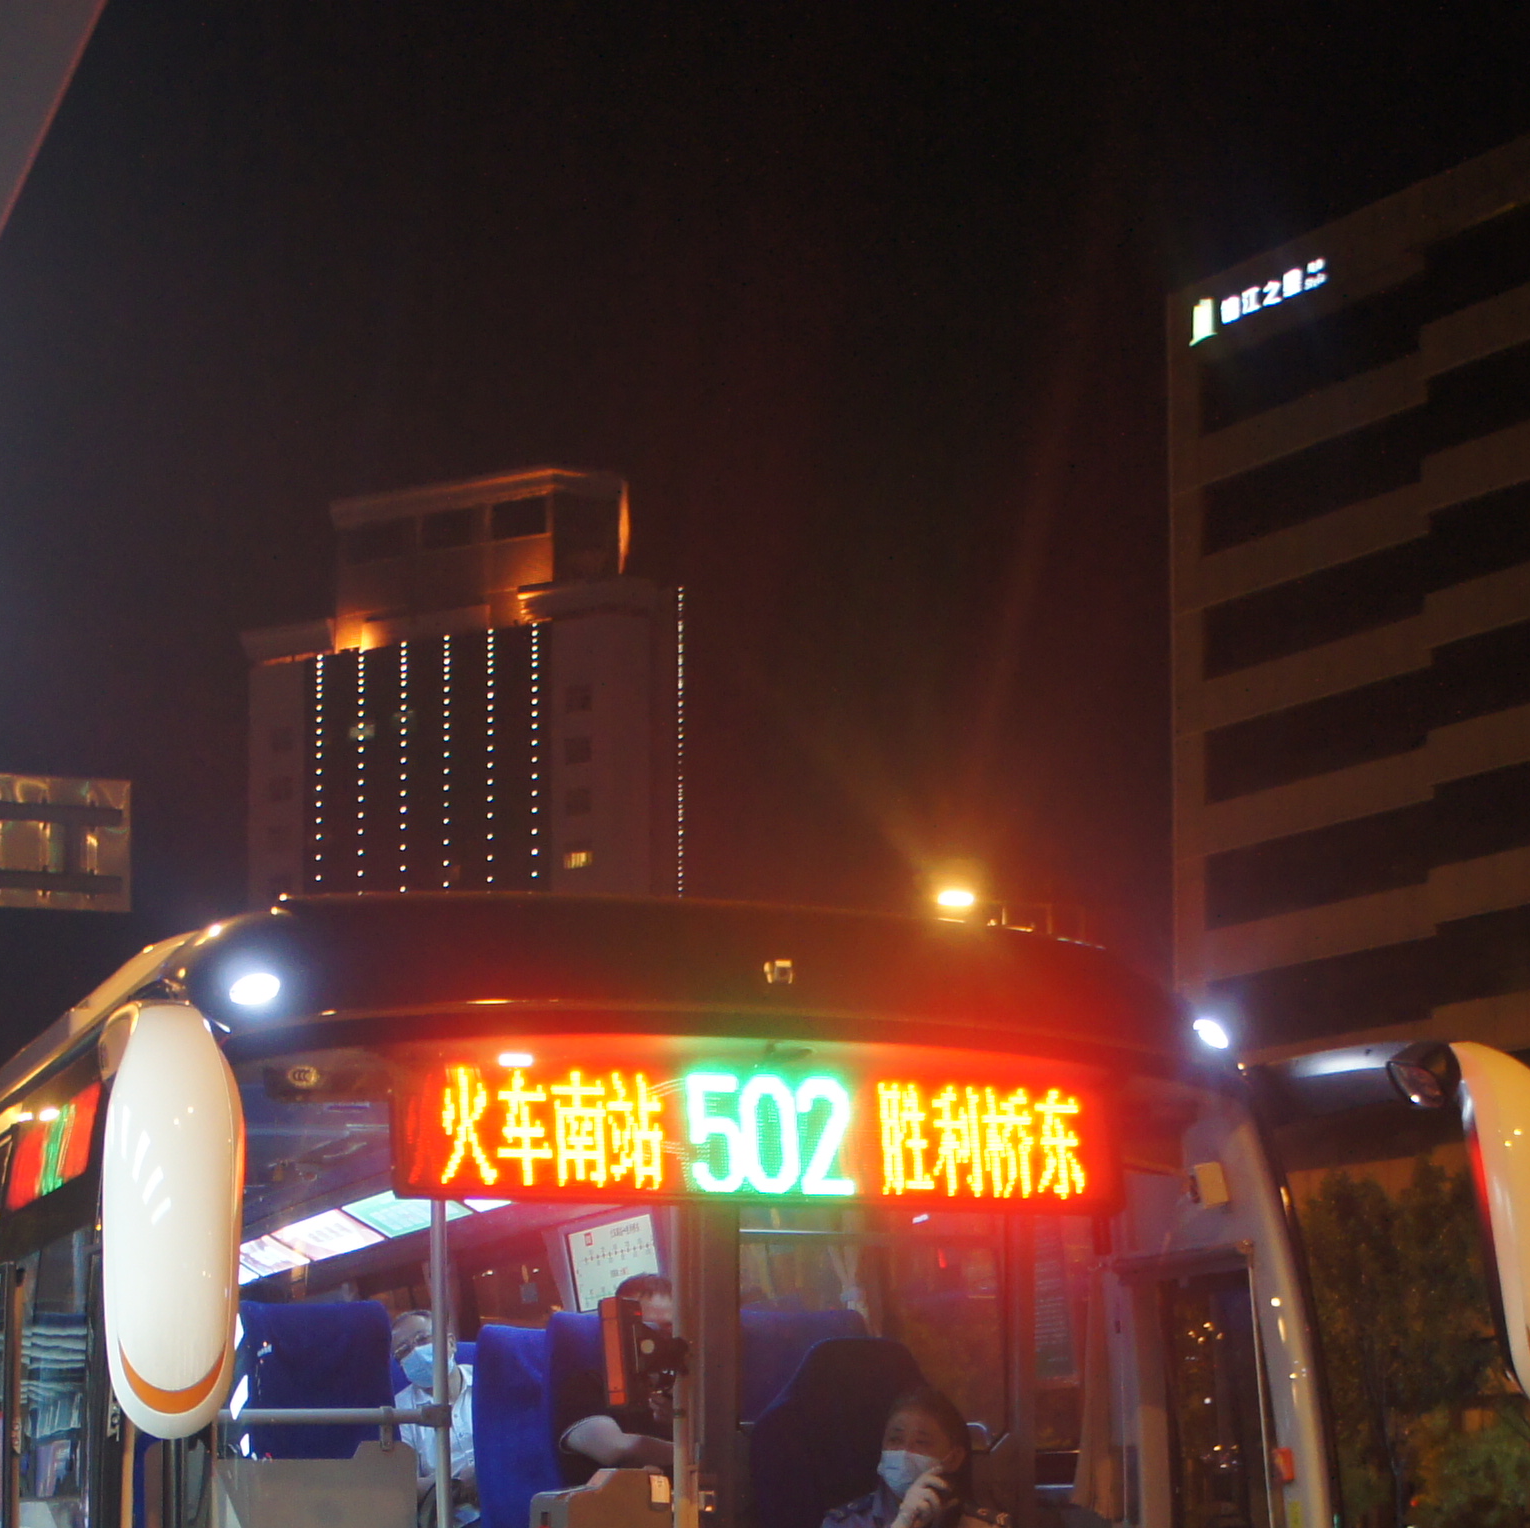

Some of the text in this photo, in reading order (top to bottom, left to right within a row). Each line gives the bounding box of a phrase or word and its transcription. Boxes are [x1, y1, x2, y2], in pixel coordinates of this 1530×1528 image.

[440, 1065, 1086, 1199] 火车南站 502 胜利桥东
